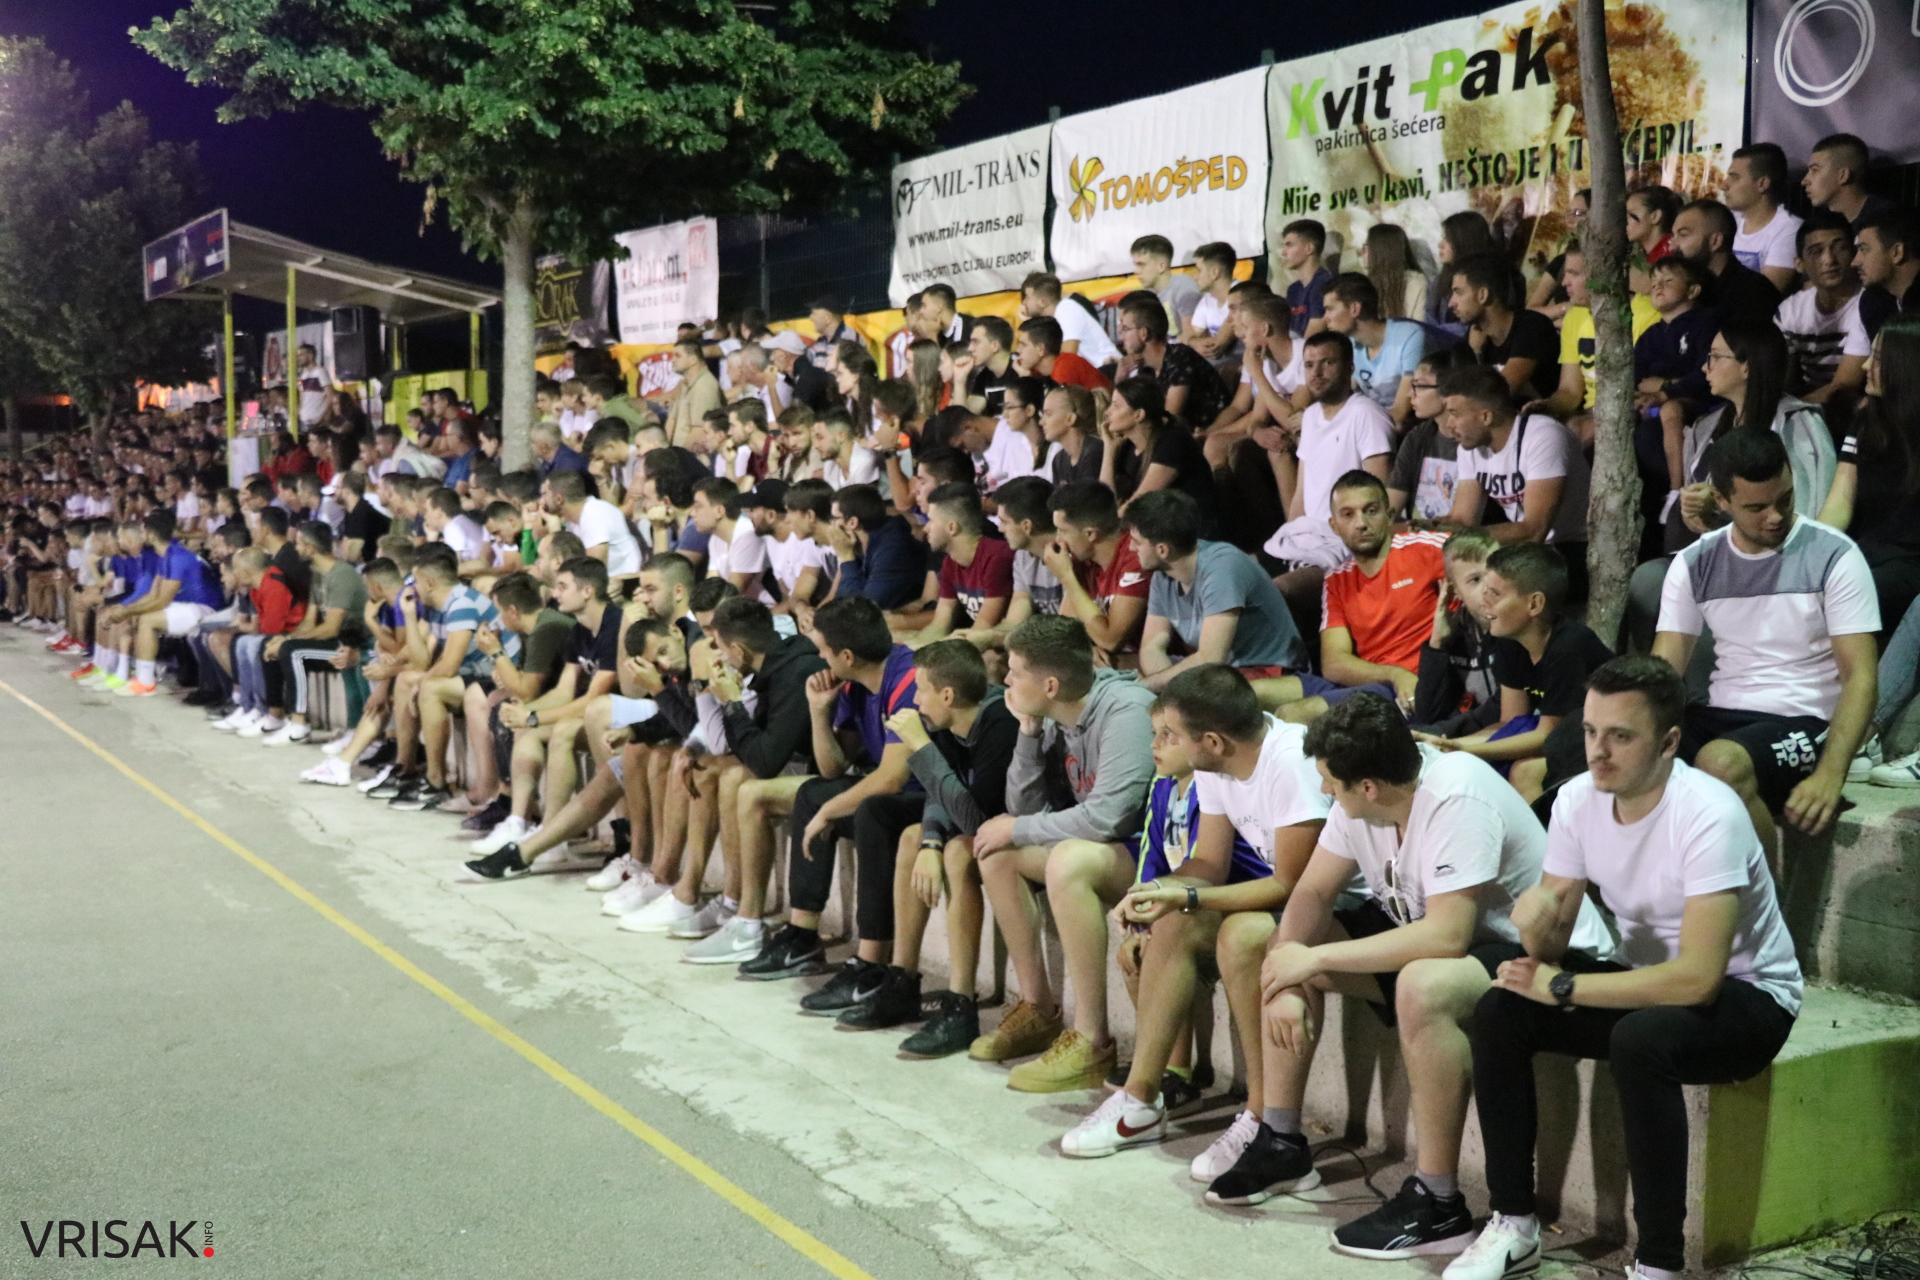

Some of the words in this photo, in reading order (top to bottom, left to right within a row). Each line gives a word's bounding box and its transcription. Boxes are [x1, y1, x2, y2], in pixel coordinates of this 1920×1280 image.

[1286, 64, 1395, 139] Kvit
[1409, 26, 1560, 112] Pak
[1315, 125, 1386, 156] pakirnica
[1392, 114, 1445, 140] šećera
[931, 150, 1041, 200] MIL-TRANS
[1099, 155, 1248, 211] TOMOŠPED
[1282, 186, 1321, 216] Nije
[1329, 186, 1357, 211] sve
[1363, 183, 1376, 204] u
[1383, 168, 1431, 203] kavi,
[1438, 149, 1508, 194] NEŠTO
[1515, 146, 1541, 185] JE
[907, 213, 1024, 248] www.mil-trans.eu
